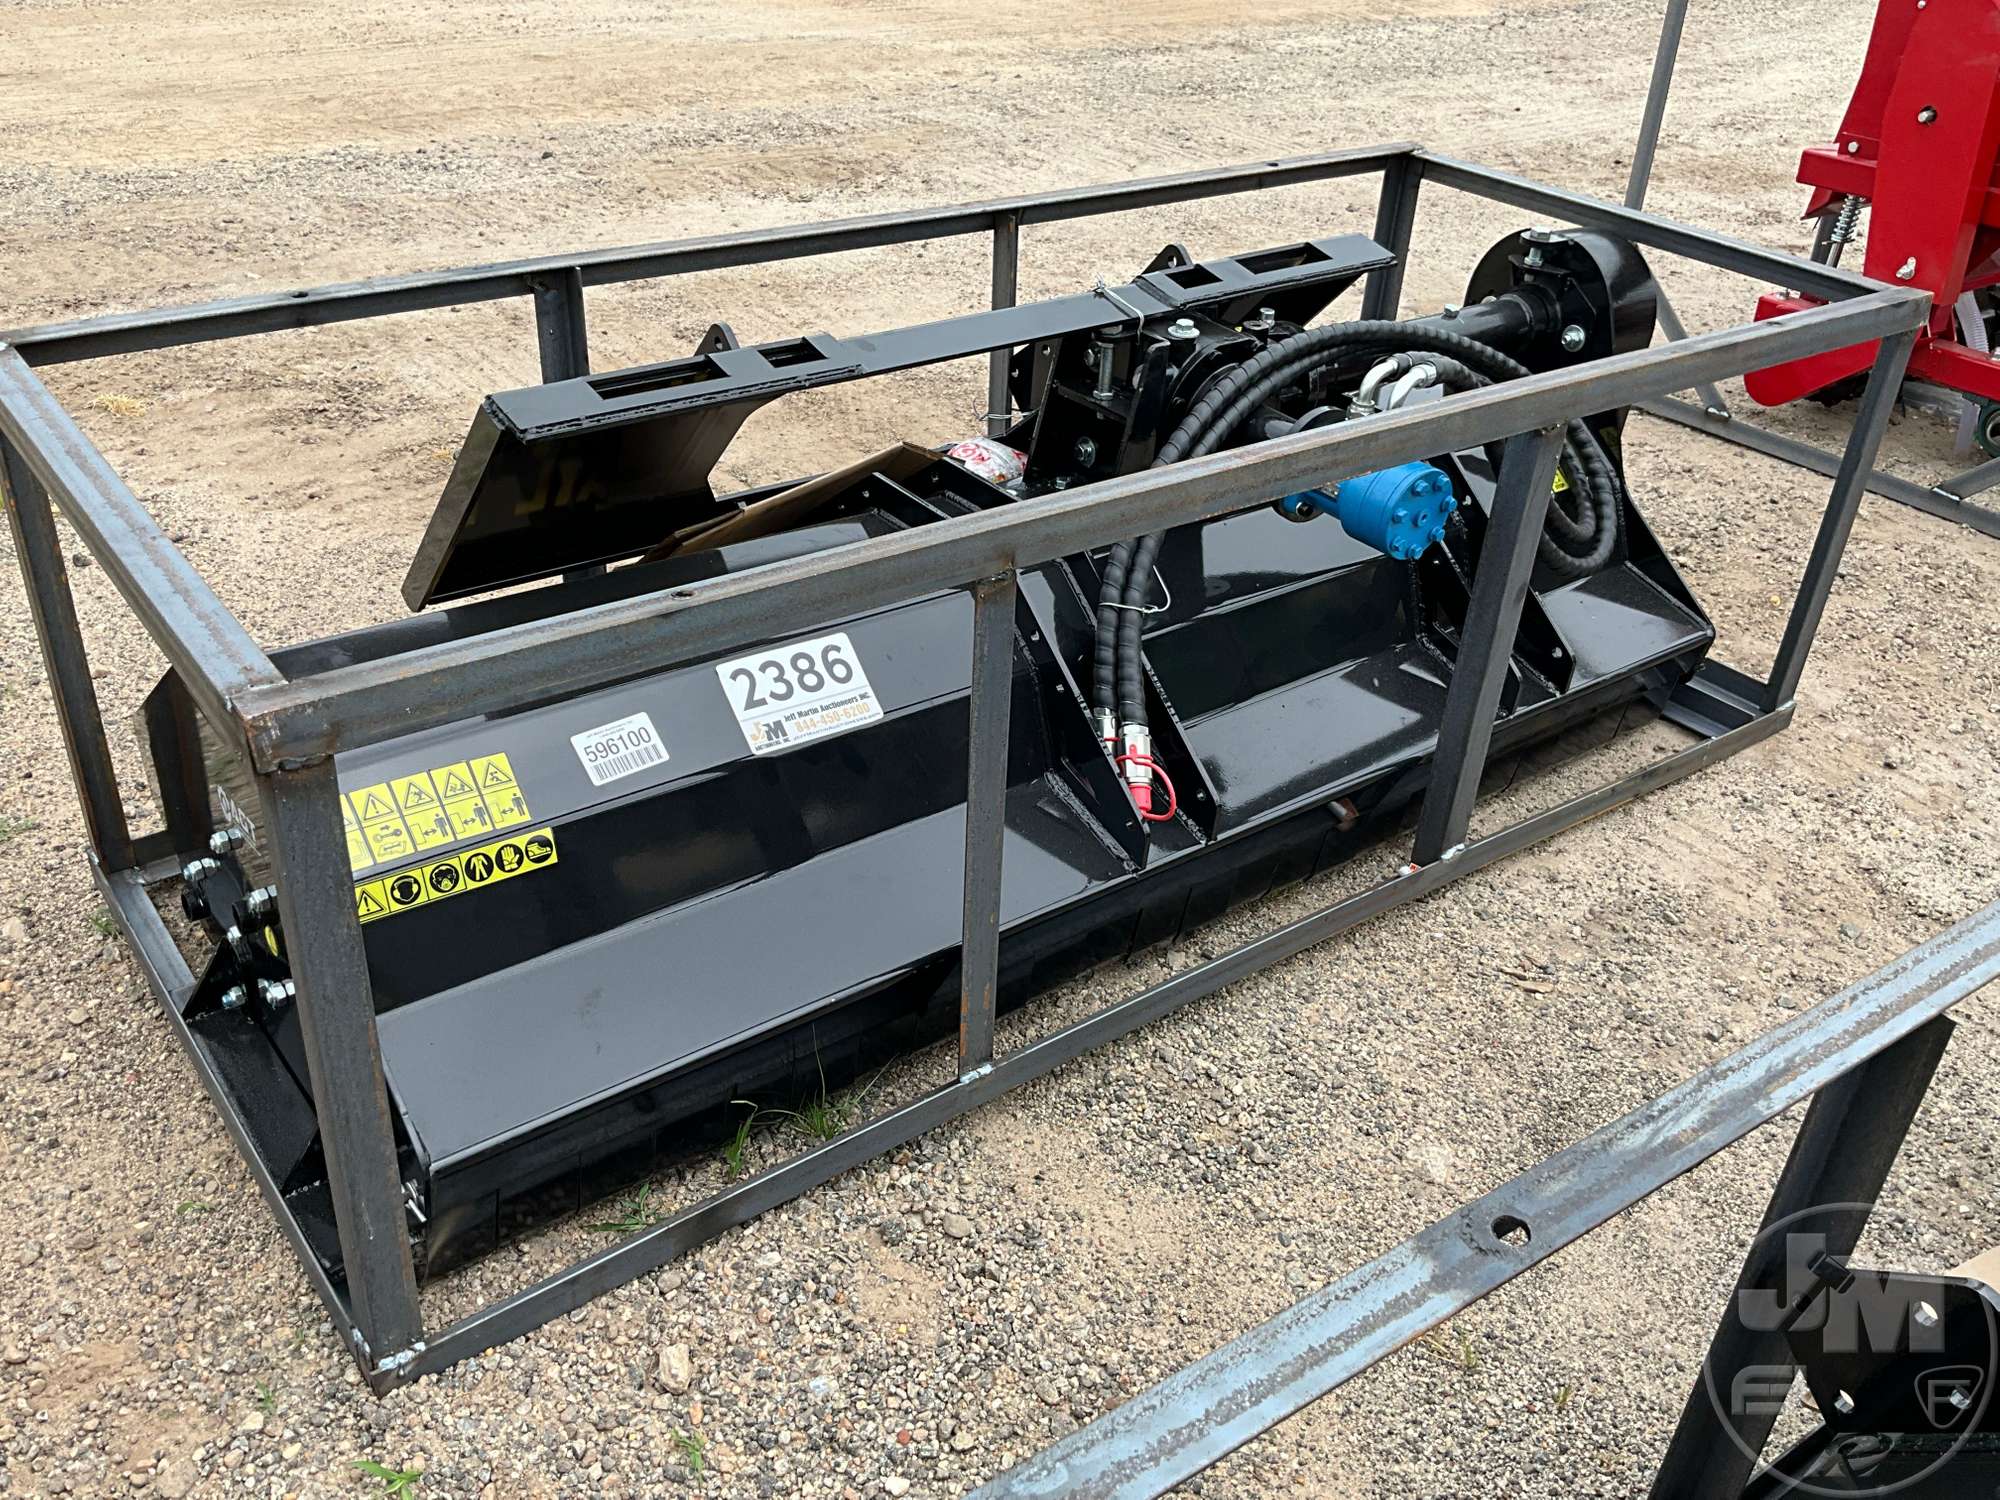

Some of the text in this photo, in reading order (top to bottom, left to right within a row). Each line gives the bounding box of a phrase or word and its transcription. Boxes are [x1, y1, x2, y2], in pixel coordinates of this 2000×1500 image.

[729, 644, 853, 711] 2386
[794, 702, 870, 732] 844-450-6200
[797, 706, 819, 720] Martin
[820, 695, 859, 712] Auctioneers
[584, 727, 651, 763] 596100
